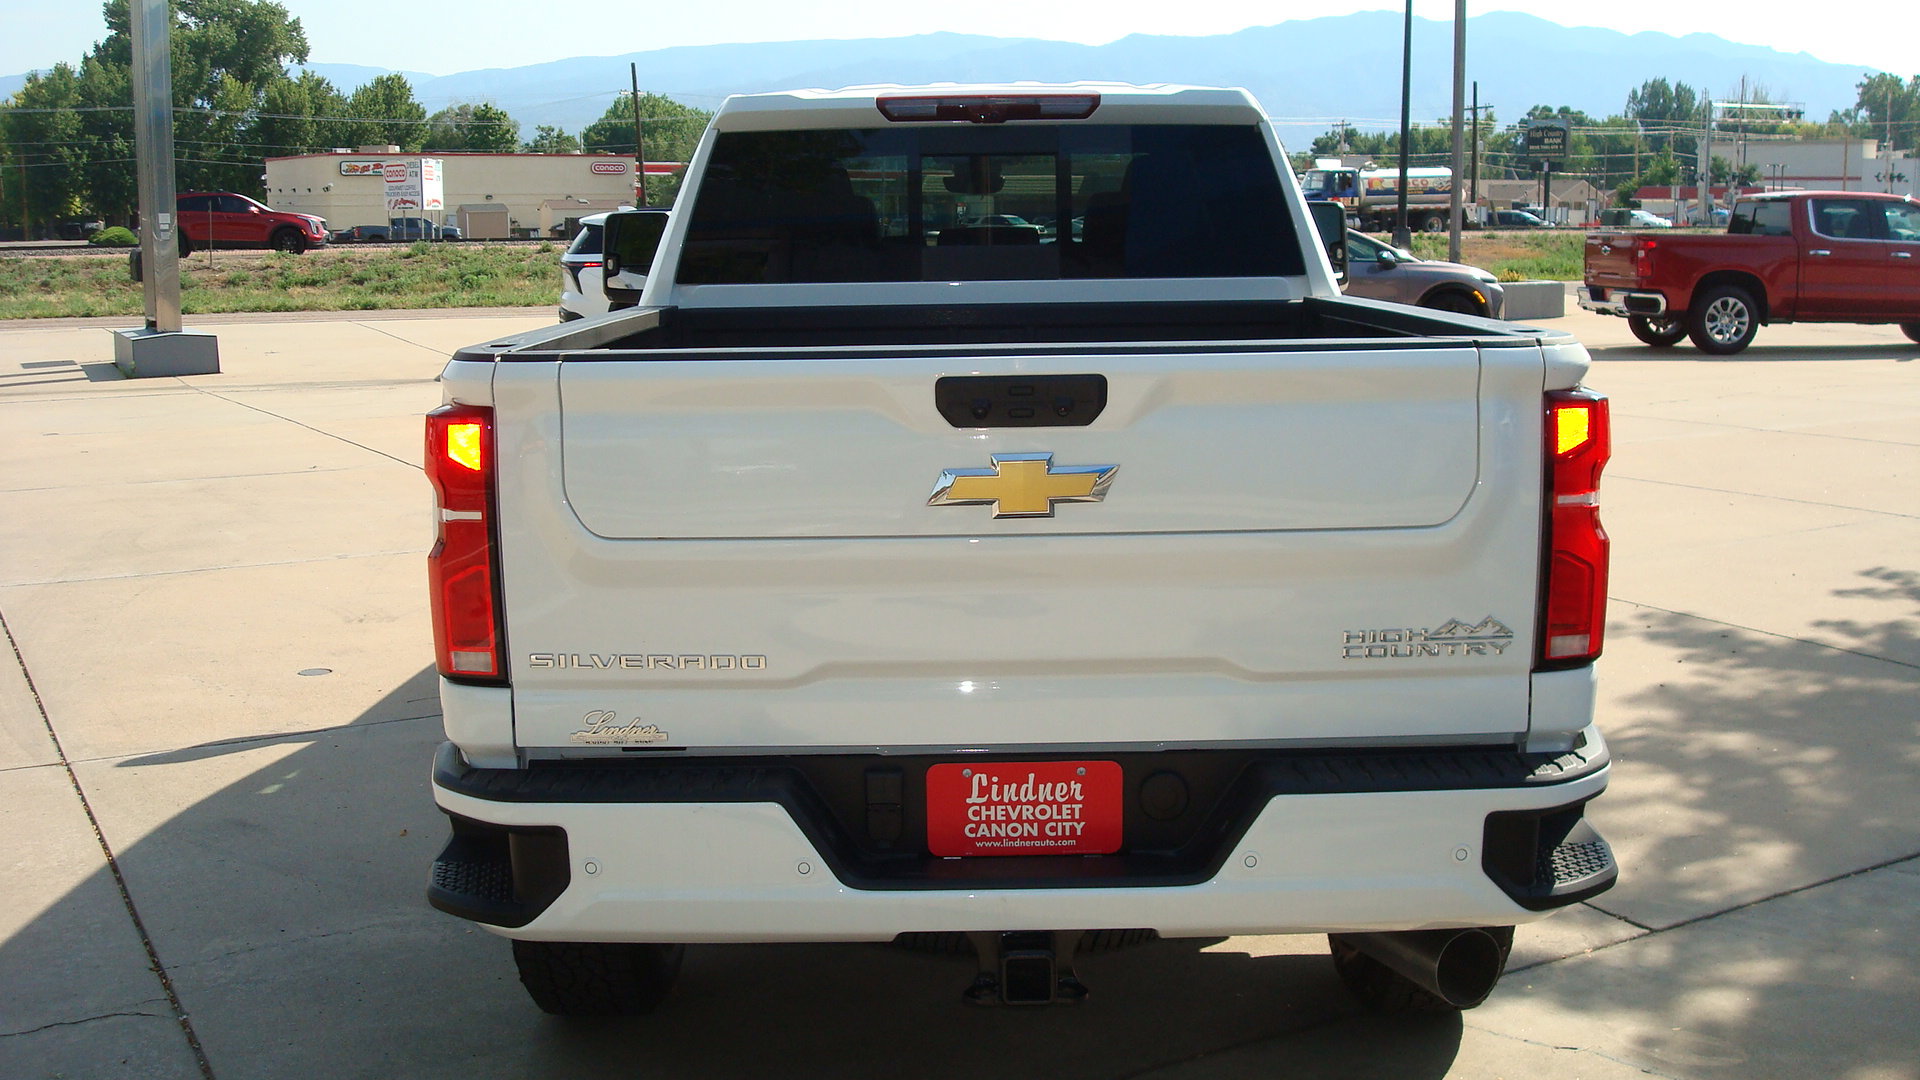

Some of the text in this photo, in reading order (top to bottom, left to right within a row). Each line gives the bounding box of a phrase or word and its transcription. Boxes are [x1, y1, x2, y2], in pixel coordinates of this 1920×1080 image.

[409, 170, 418, 178] ATM
[1343, 628, 1429, 644] HIGH
[1342, 641, 1512, 659] COUNTRY
[529, 653, 768, 670] SILVERADO
[577, 710, 660, 736] Lindner
[965, 773, 1085, 804] Lindner
[967, 804, 1083, 821] CHEVROLET
[964, 821, 1086, 838] CANON CITY
[975, 838, 1076, 848] www.lindnerauto.com
